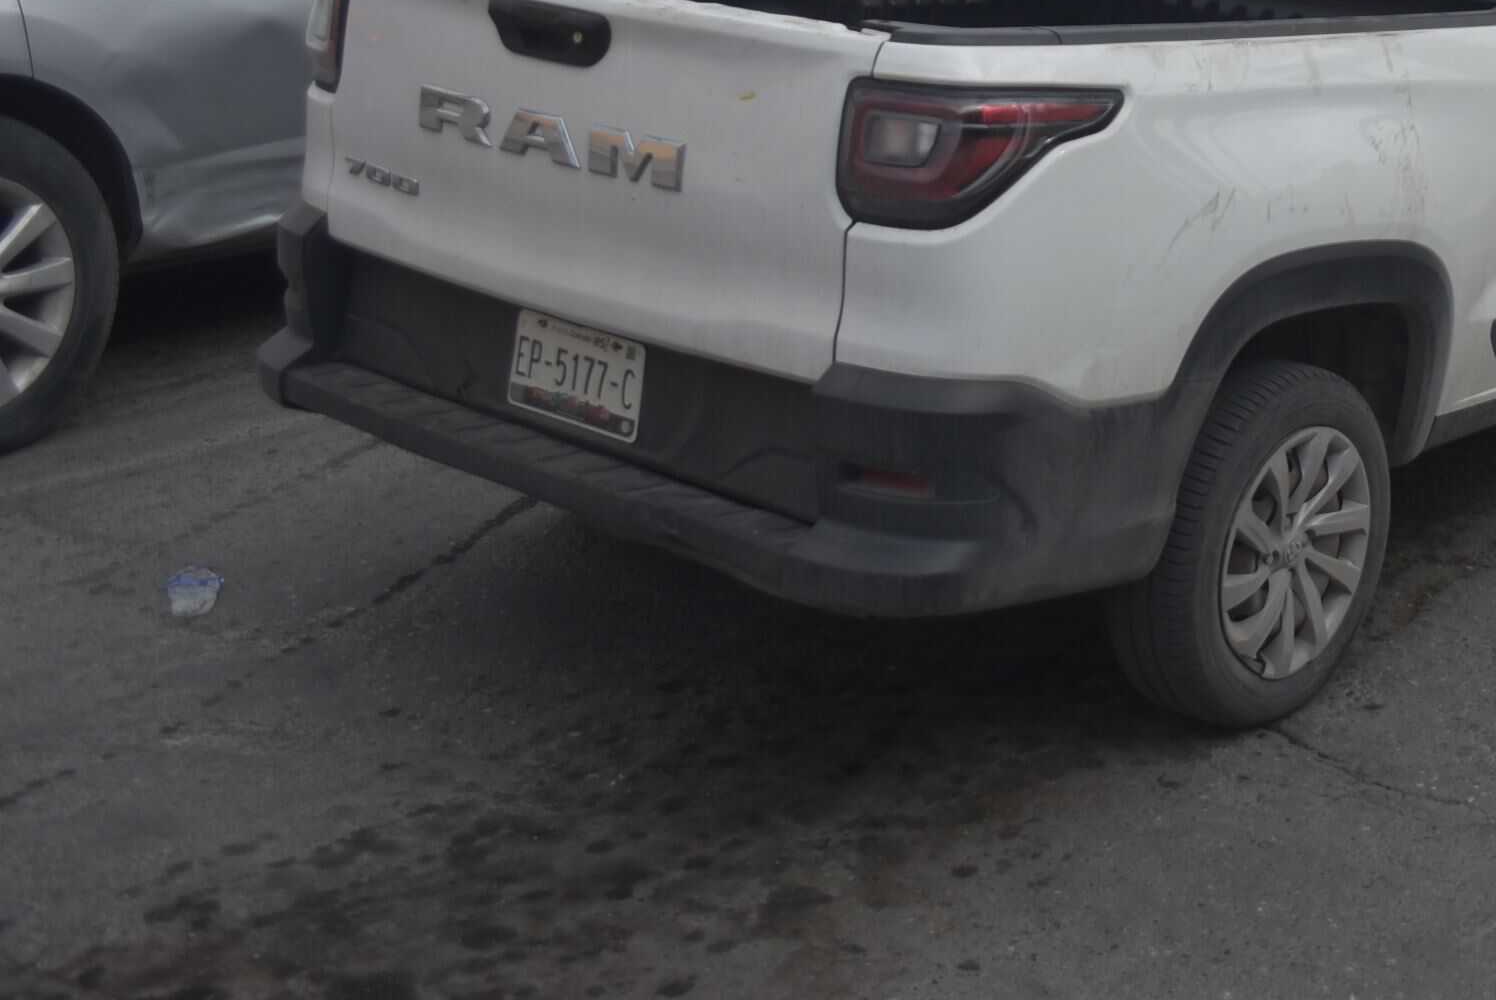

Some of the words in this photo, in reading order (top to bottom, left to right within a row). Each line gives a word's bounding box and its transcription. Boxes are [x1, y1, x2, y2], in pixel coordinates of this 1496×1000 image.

[419, 84, 687, 192] RAM
[344, 156, 420, 196] 700
[514, 335, 636, 410] EP-5177-C
